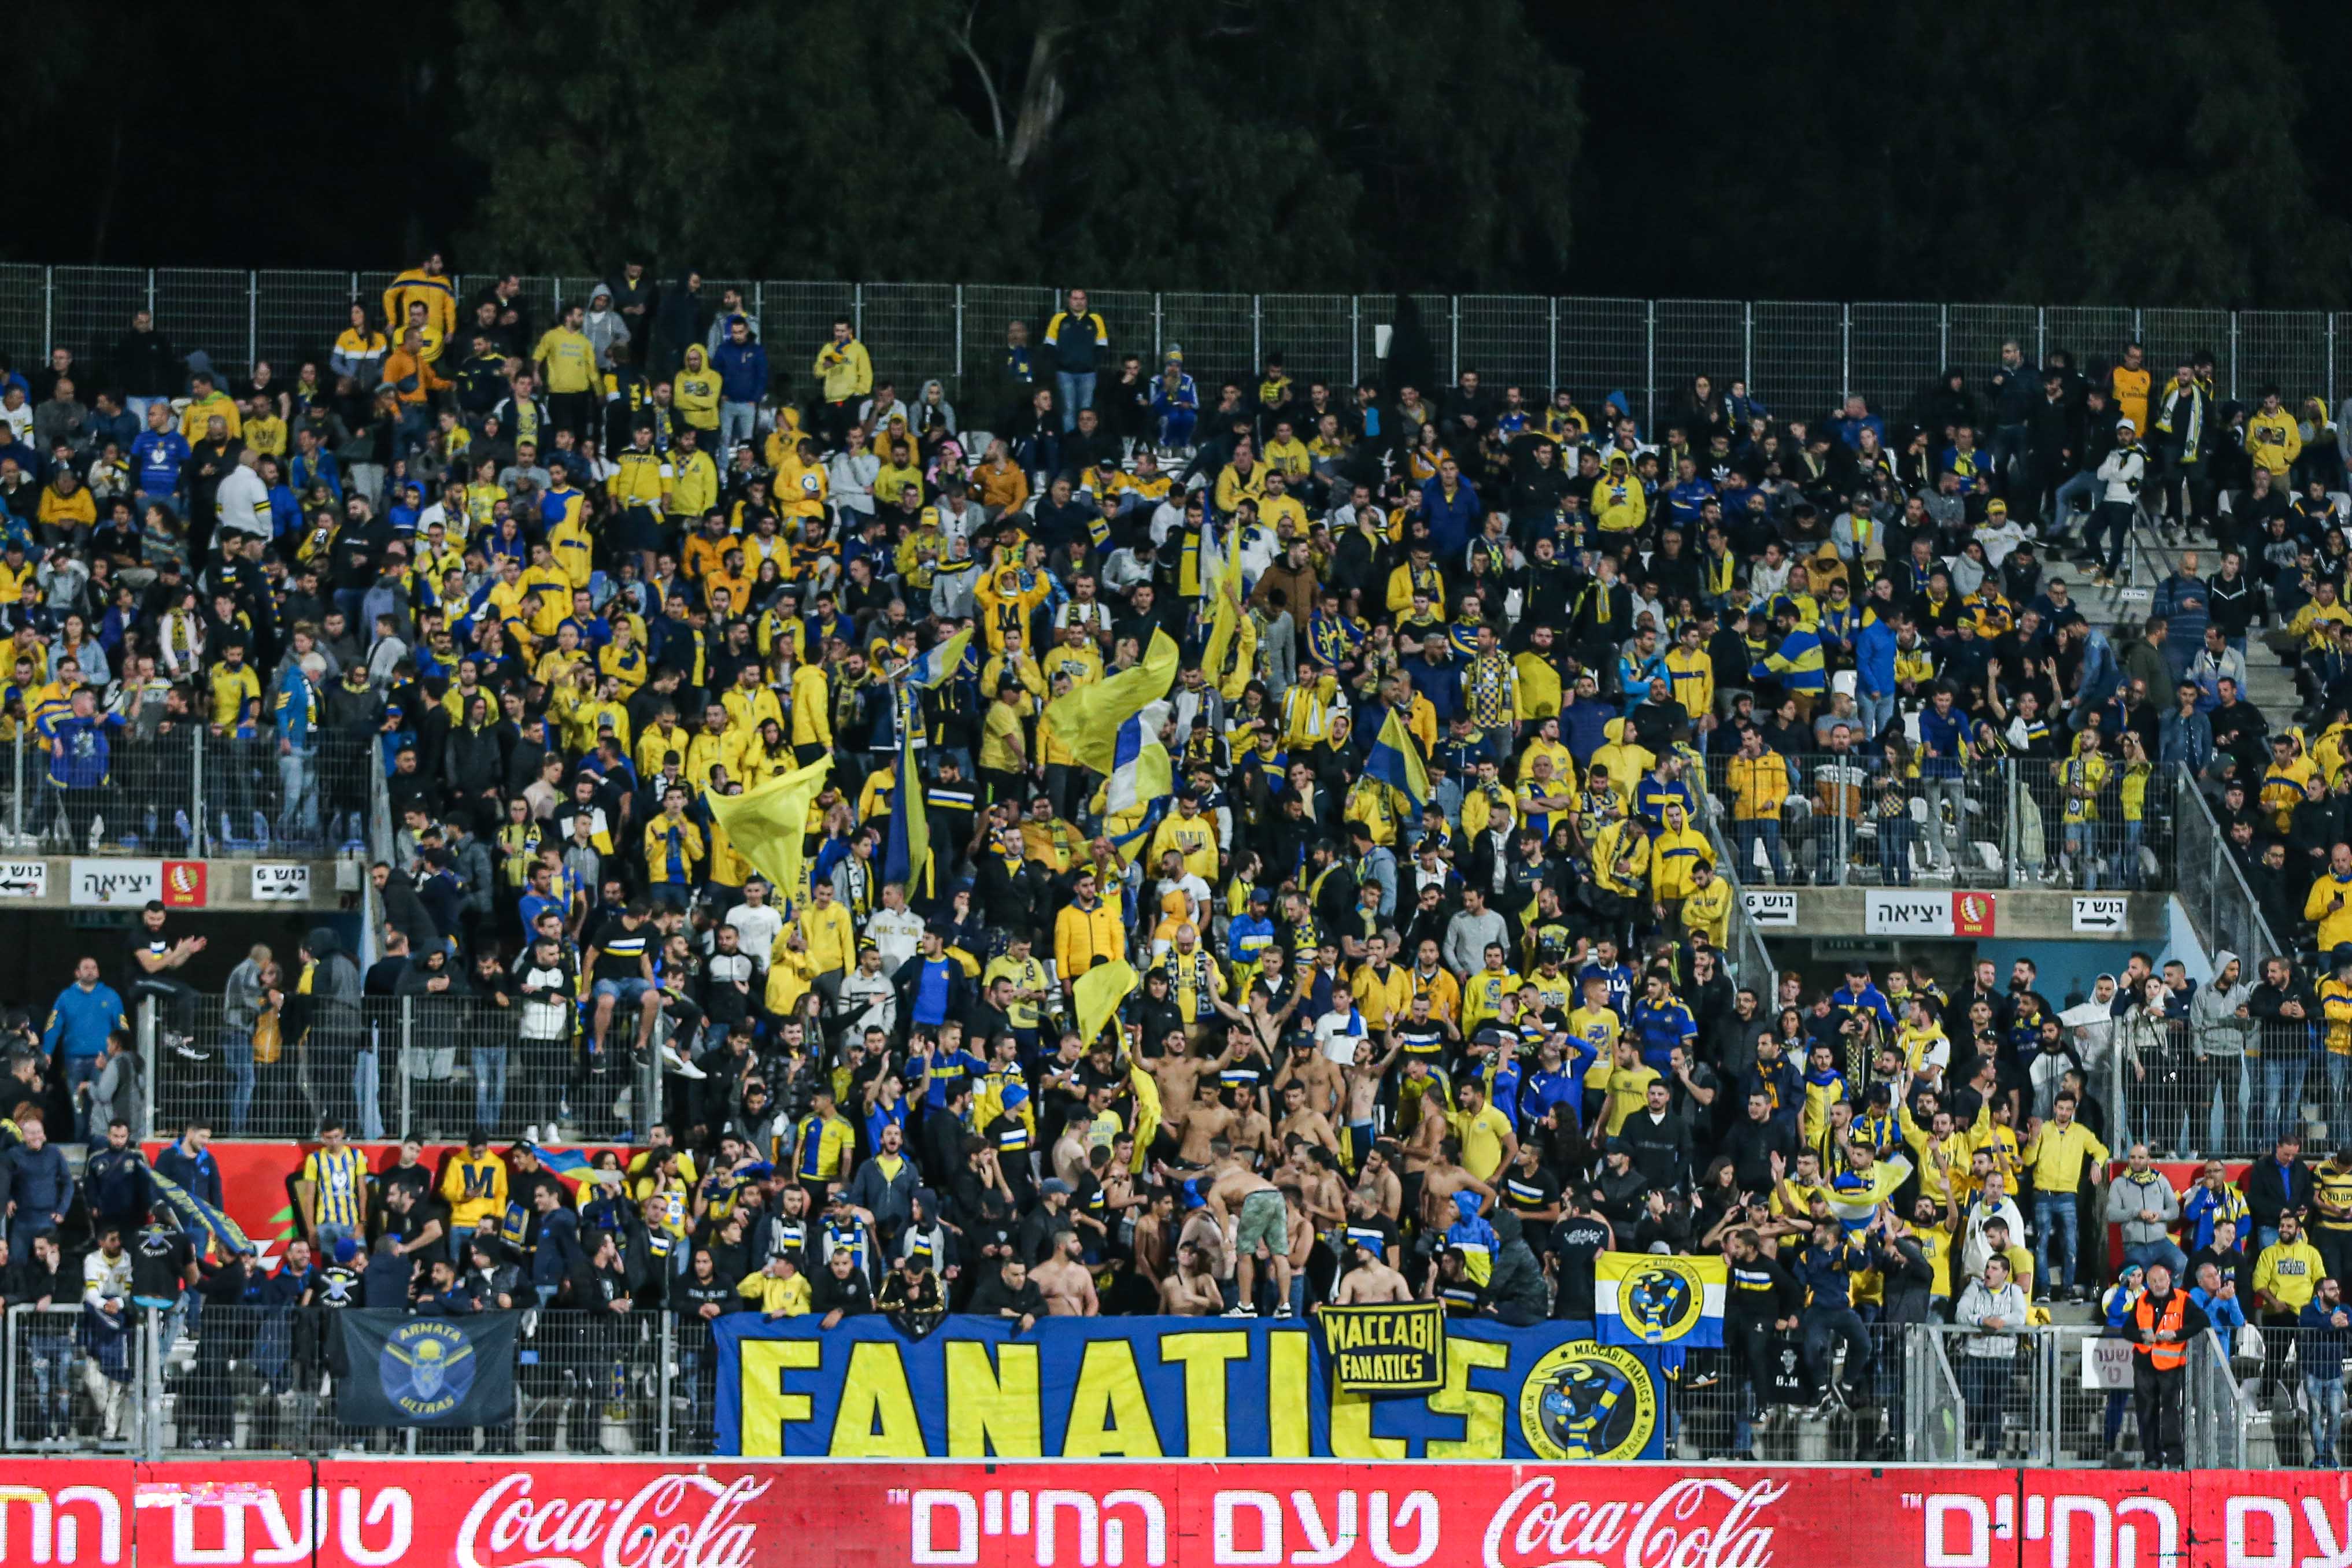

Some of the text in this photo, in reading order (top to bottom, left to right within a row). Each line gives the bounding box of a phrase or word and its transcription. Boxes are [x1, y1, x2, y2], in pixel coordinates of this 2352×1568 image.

[11, 866, 42, 877] גוש
[257, 869, 306, 881] גוש 6
[84, 872, 152, 894] יציאה
[1747, 896, 1793, 907] גוש 6
[2077, 902, 2122, 914] גוש 7
[1878, 904, 1943, 922] יציאה
[1606, 979, 1630, 992] ILA
[462, 1164, 495, 1199] M
[400, 1322, 461, 1341] ARMATA
[1325, 1313, 1434, 1355] MACCABI
[2094, 1348, 2130, 1362] שער
[1340, 1354, 1423, 1381] FANATICS
[1574, 1344, 1650, 1403] MACCABI FANATICS
[399, 1395, 454, 1413] ULTRAS
[456, 1473, 774, 1568] Coca-Cola
[911, 1489, 1166, 1566] החיים
[1213, 1489, 1439, 1566] טעם
[1482, 1475, 1791, 1568] Coca-Cola
[1924, 1493, 2179, 1568] החיים
